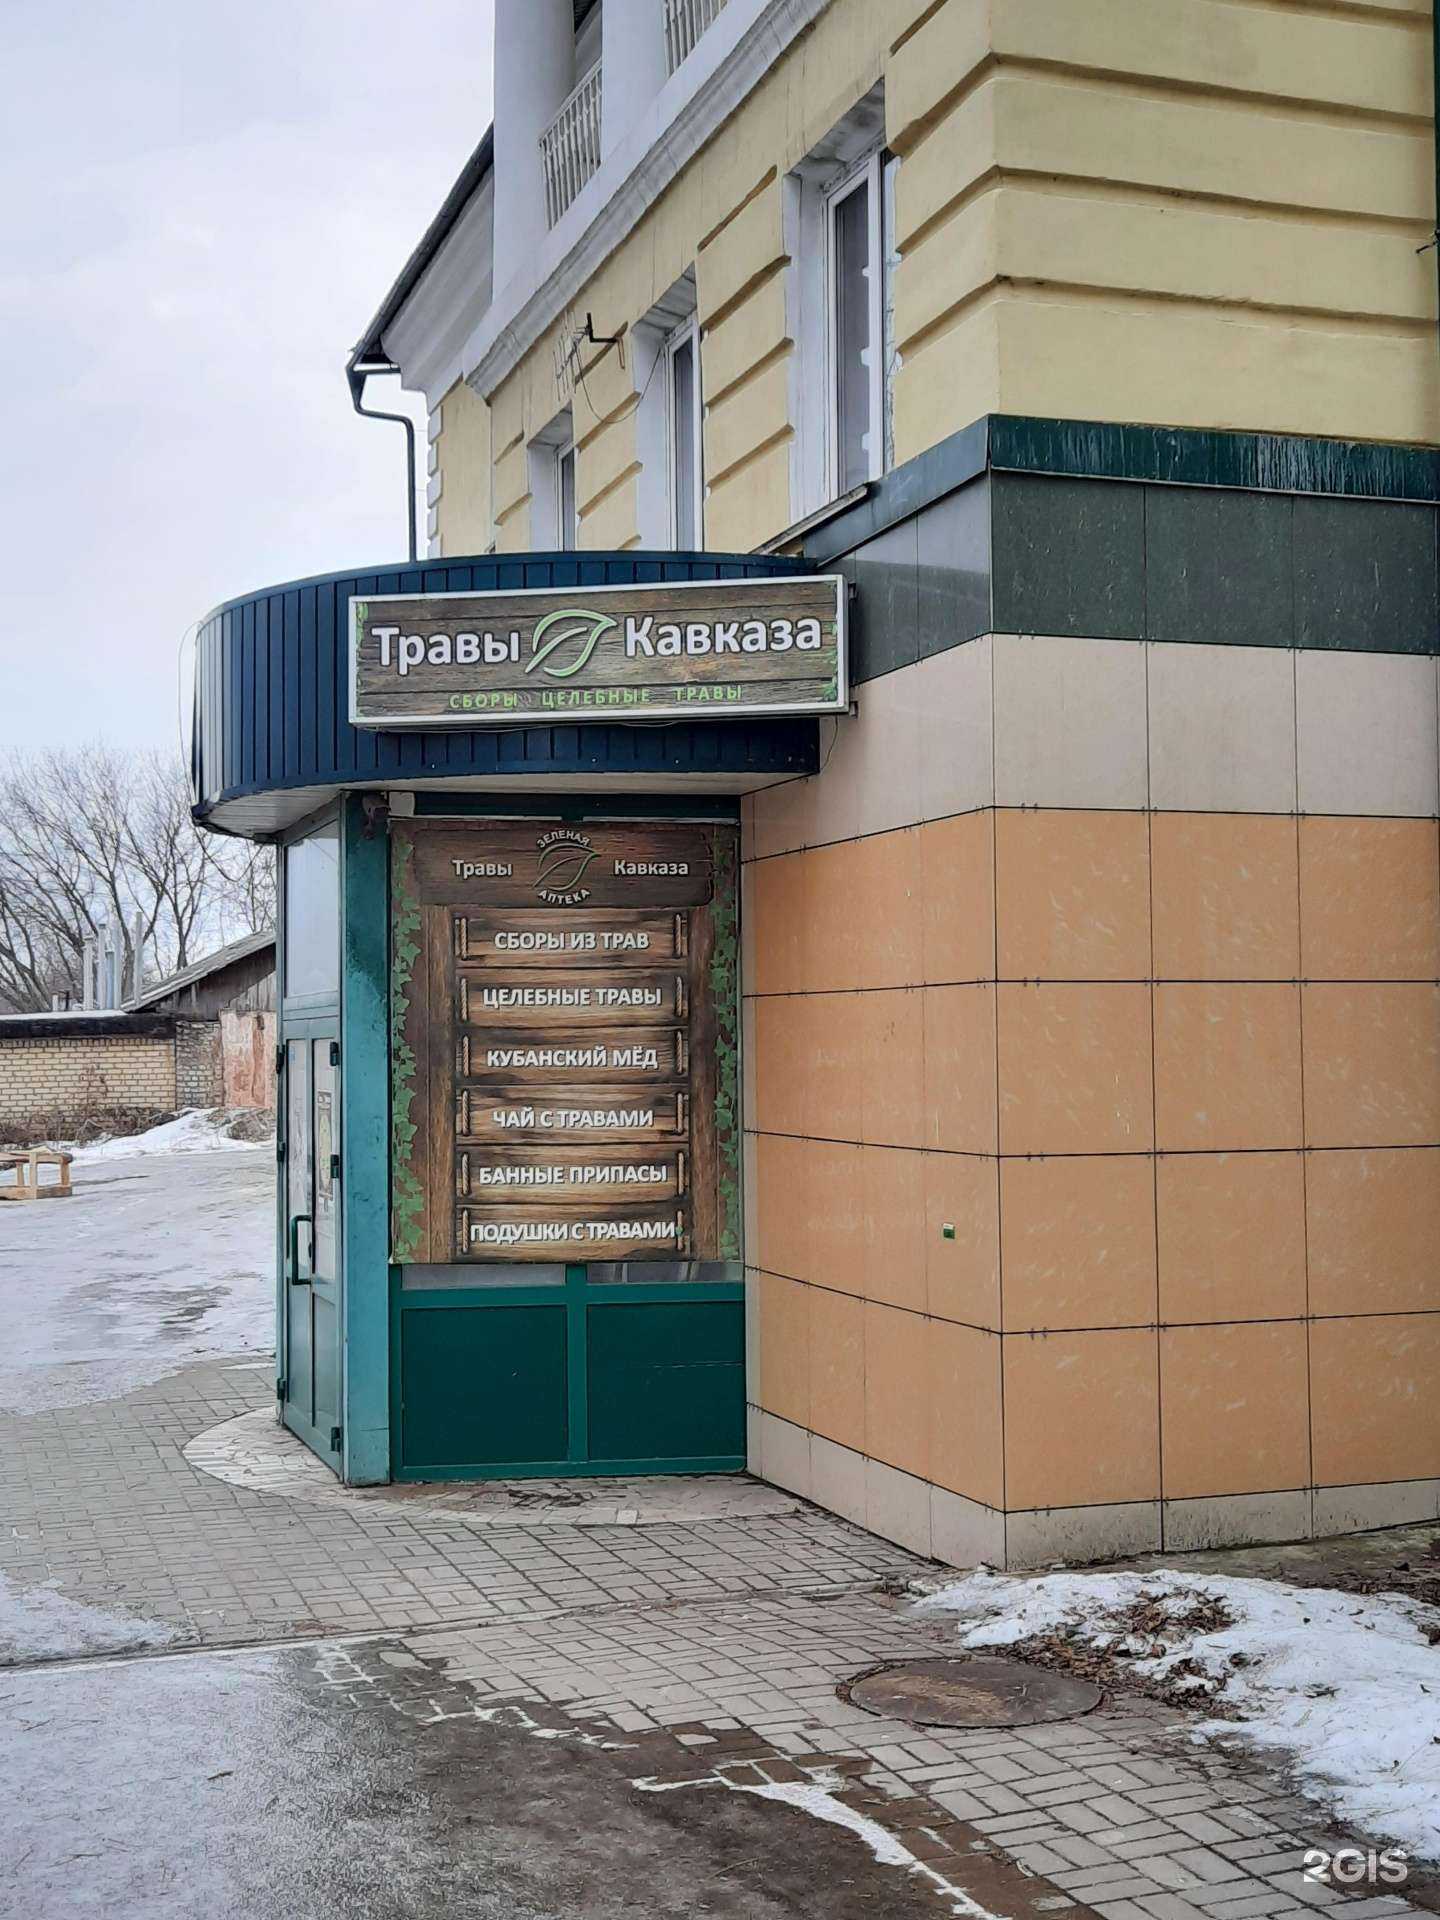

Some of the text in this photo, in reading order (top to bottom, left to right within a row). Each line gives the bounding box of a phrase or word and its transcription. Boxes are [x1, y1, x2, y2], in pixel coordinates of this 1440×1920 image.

[372, 617, 821, 675] Травы Кавказа
[449, 685, 742, 709] СБОРЫ ЦЕЛЕБНЫЕ ТРАВЫ
[536, 829, 590, 848] ЗЕЛЕНАЯ
[452, 860, 688, 878] Травы Кавказа
[538, 889, 591, 904] АПТЕКА
[495, 933, 649, 949] СБОРЫ ИЗ ТРАВ
[483, 989, 661, 1007] ЦЕЛЕБНЫЕ ТРАВЫ
[487, 1046, 658, 1069] КУБАНСКИЙ МЁД
[493, 1107, 653, 1127] ЧАЙ С ТРАВАМИ
[480, 1166, 666, 1184] БАННЫЕ ПРИПАСЫ
[471, 1222, 676, 1244] ПОДУШКИ С ТРАВАМИ
